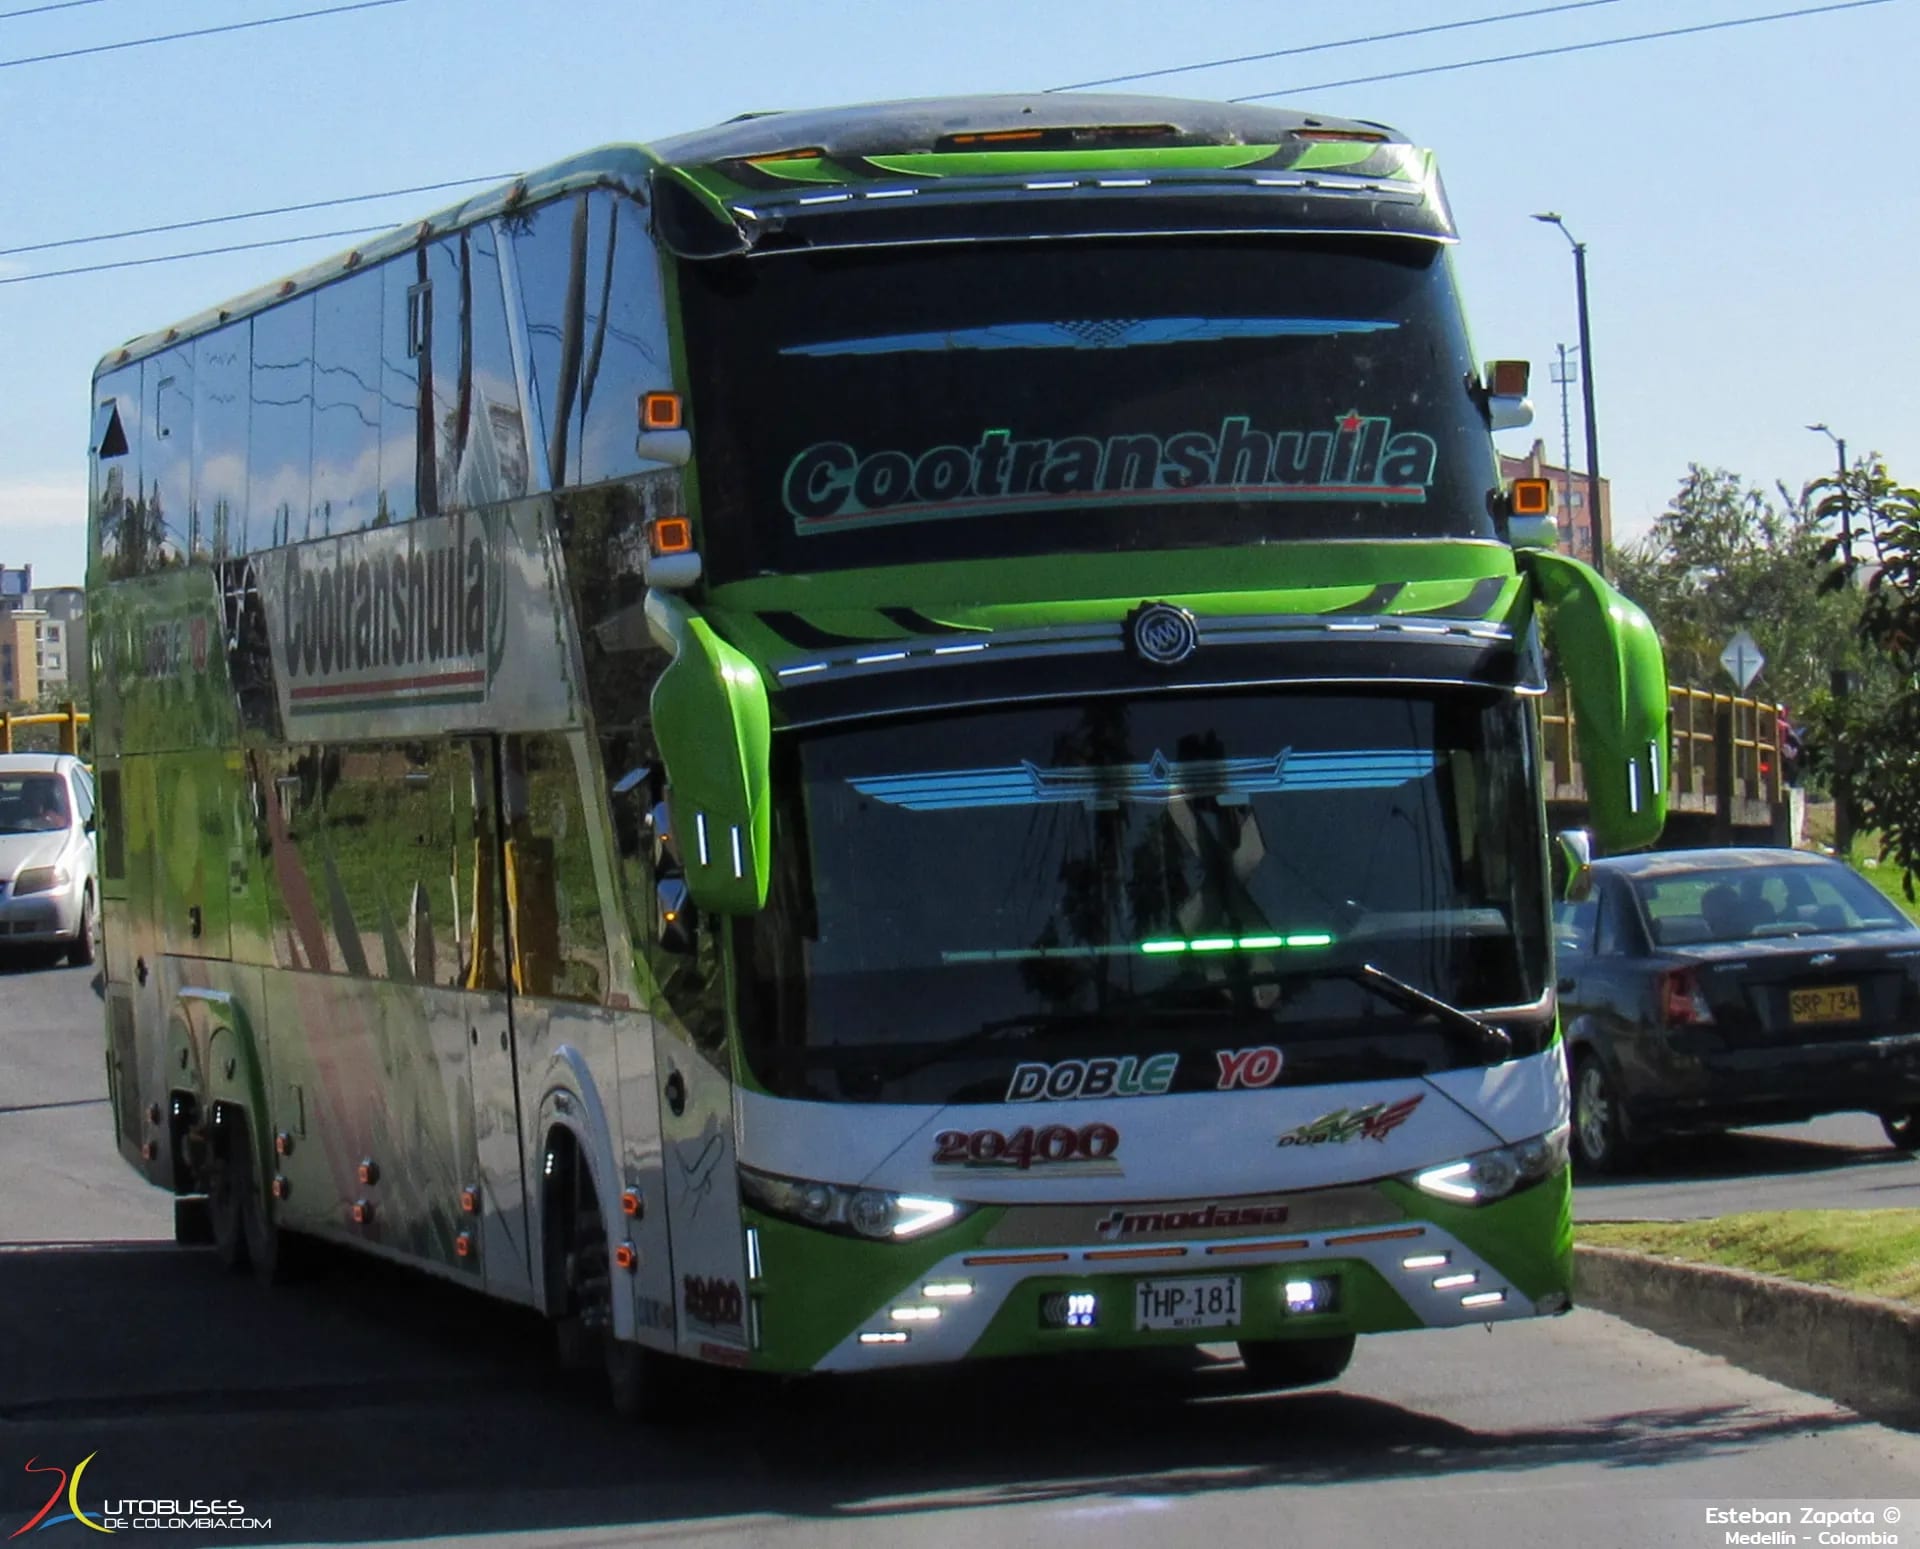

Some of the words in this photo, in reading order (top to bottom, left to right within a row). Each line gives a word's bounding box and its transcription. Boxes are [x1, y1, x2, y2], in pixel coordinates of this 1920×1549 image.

[782, 414, 1438, 521] Cootranshuila
[1005, 1053, 1179, 1103] DOBLE
[1216, 1046, 1283, 1090] YO
[932, 1122, 1120, 1169] 20400
[1121, 1204, 1289, 1234] modasa
